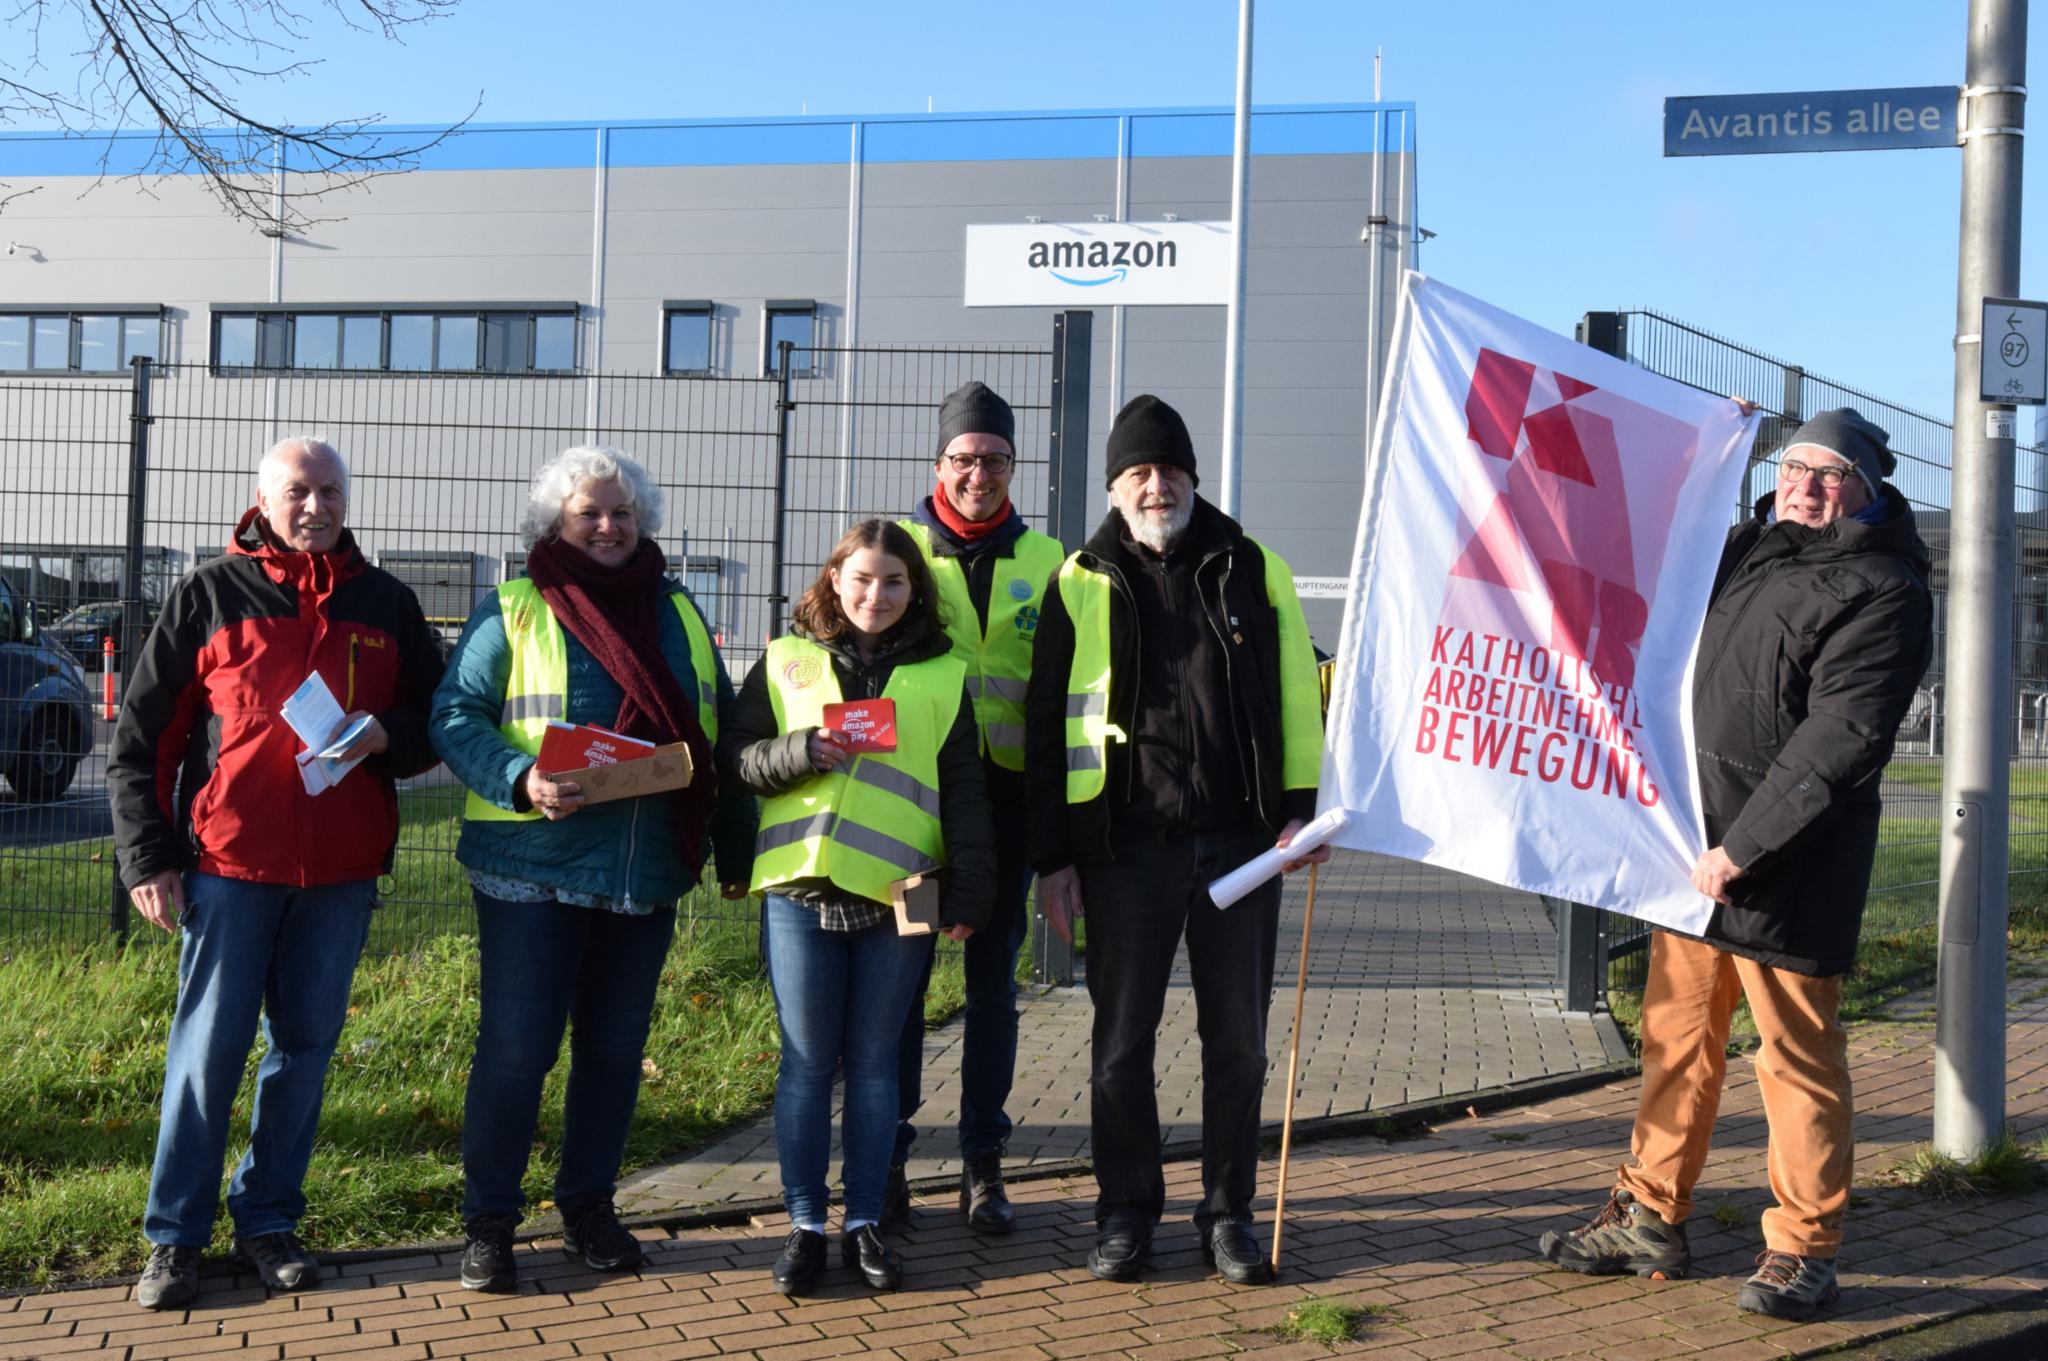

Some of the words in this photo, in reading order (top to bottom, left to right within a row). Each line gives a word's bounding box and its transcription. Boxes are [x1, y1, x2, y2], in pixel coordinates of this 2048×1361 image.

[1681, 104, 1832, 140] Avantis
[1846, 102, 1941, 134] allee
[1028, 240, 1177, 268] amazon
[2003, 342, 2025, 358] 97
[1294, 582, 1350, 591] AUPTEINGAN
[1430, 624, 1644, 729] KATHOLISH
[845, 709, 869, 719] make
[1422, 666, 1642, 756] ARBEITNEHME
[842, 720, 875, 731] amazon
[851, 732, 867, 743] pay
[592, 740, 616, 753] make
[584, 749, 617, 765] amazon
[1415, 705, 1660, 808] BEWEGUNG
